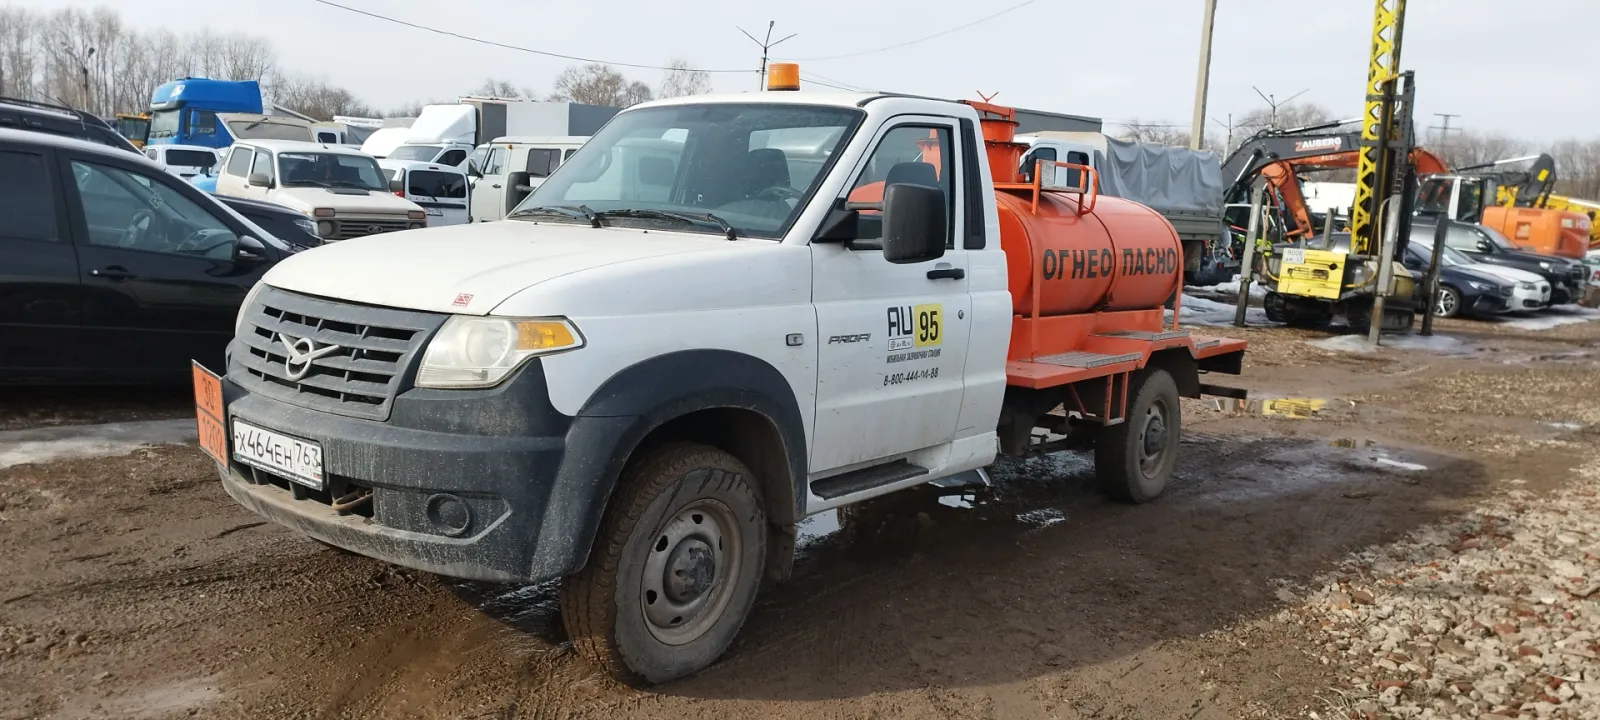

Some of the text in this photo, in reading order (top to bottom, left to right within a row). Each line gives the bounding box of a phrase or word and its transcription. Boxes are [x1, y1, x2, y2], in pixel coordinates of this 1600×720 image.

[1295, 136, 1342, 152] ZAUBERG
[1043, 247, 1176, 280] ОГНЕО ПАСНО
[919, 310, 939, 342] 95
[202, 376, 215, 411] 30
[202, 417, 224, 459] 1202
[295, 443, 319, 469] 763
